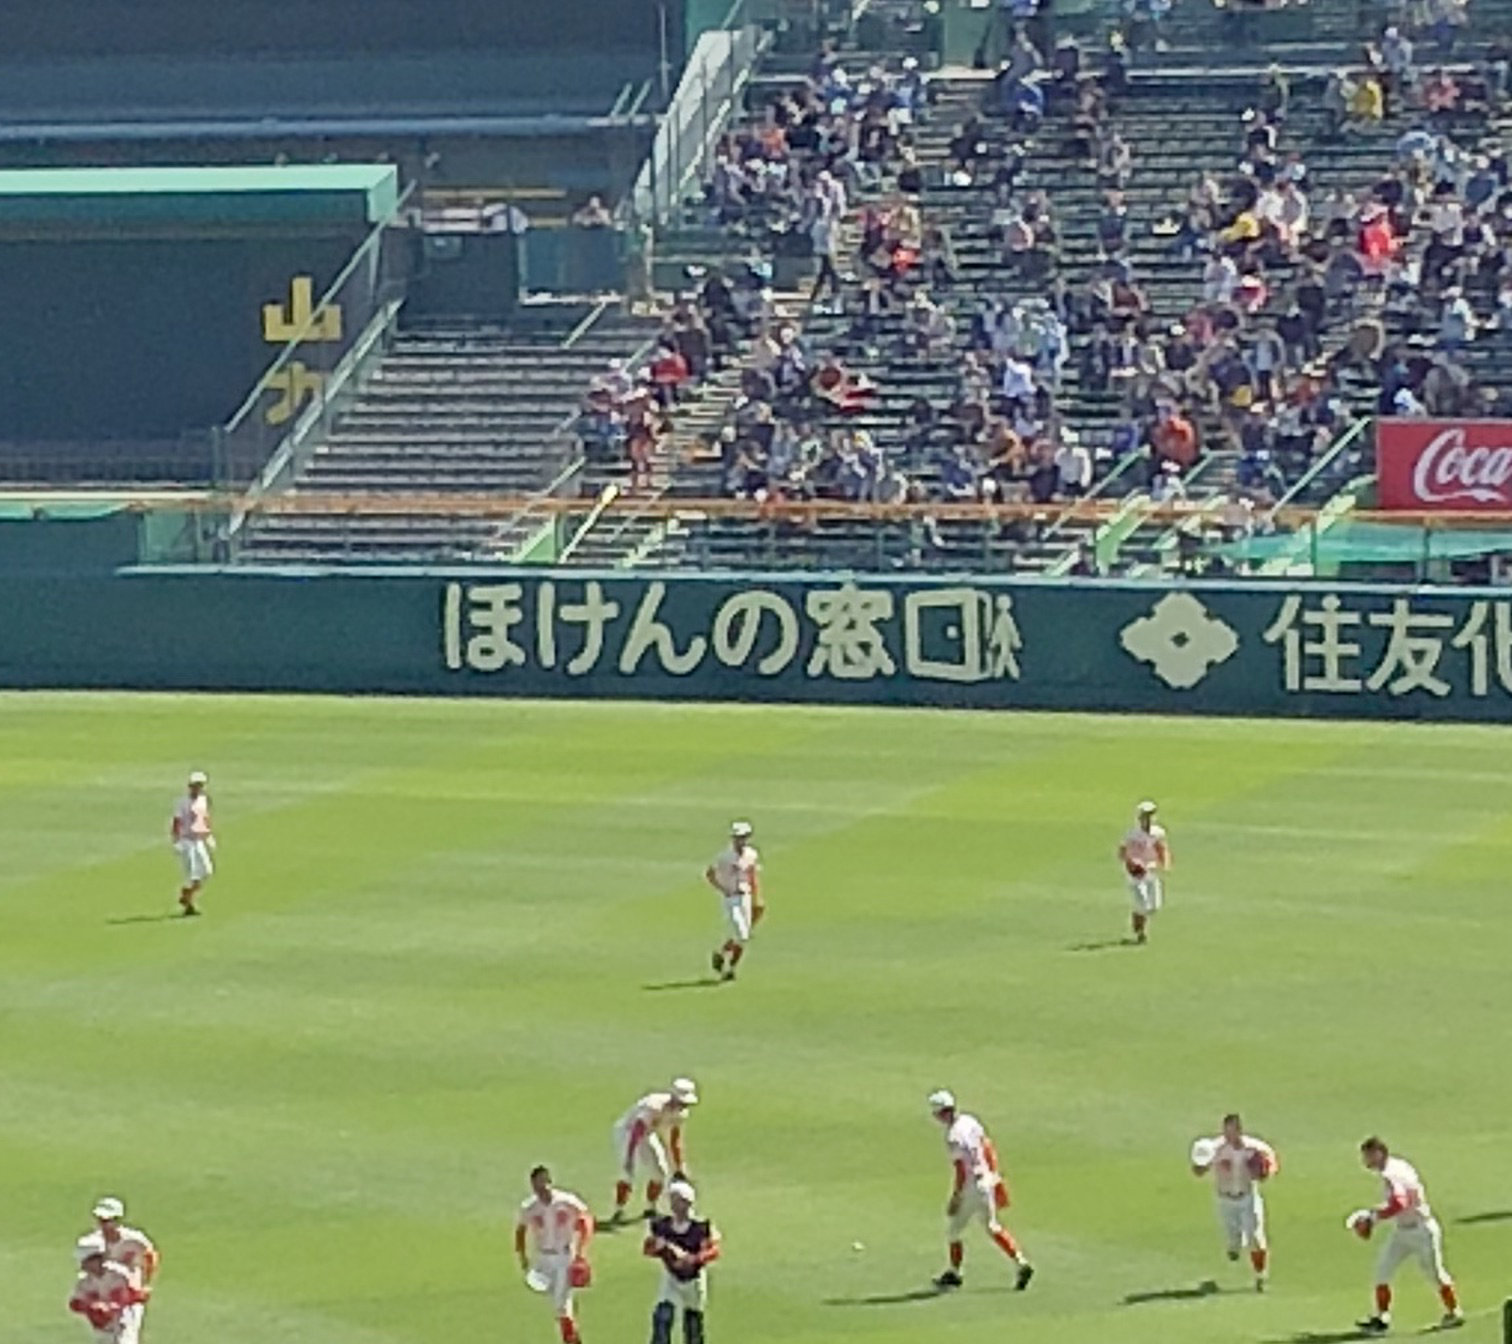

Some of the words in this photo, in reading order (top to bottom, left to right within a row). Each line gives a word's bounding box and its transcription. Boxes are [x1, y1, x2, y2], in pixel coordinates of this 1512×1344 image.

[444, 578, 988, 683] ほけんの窓口
